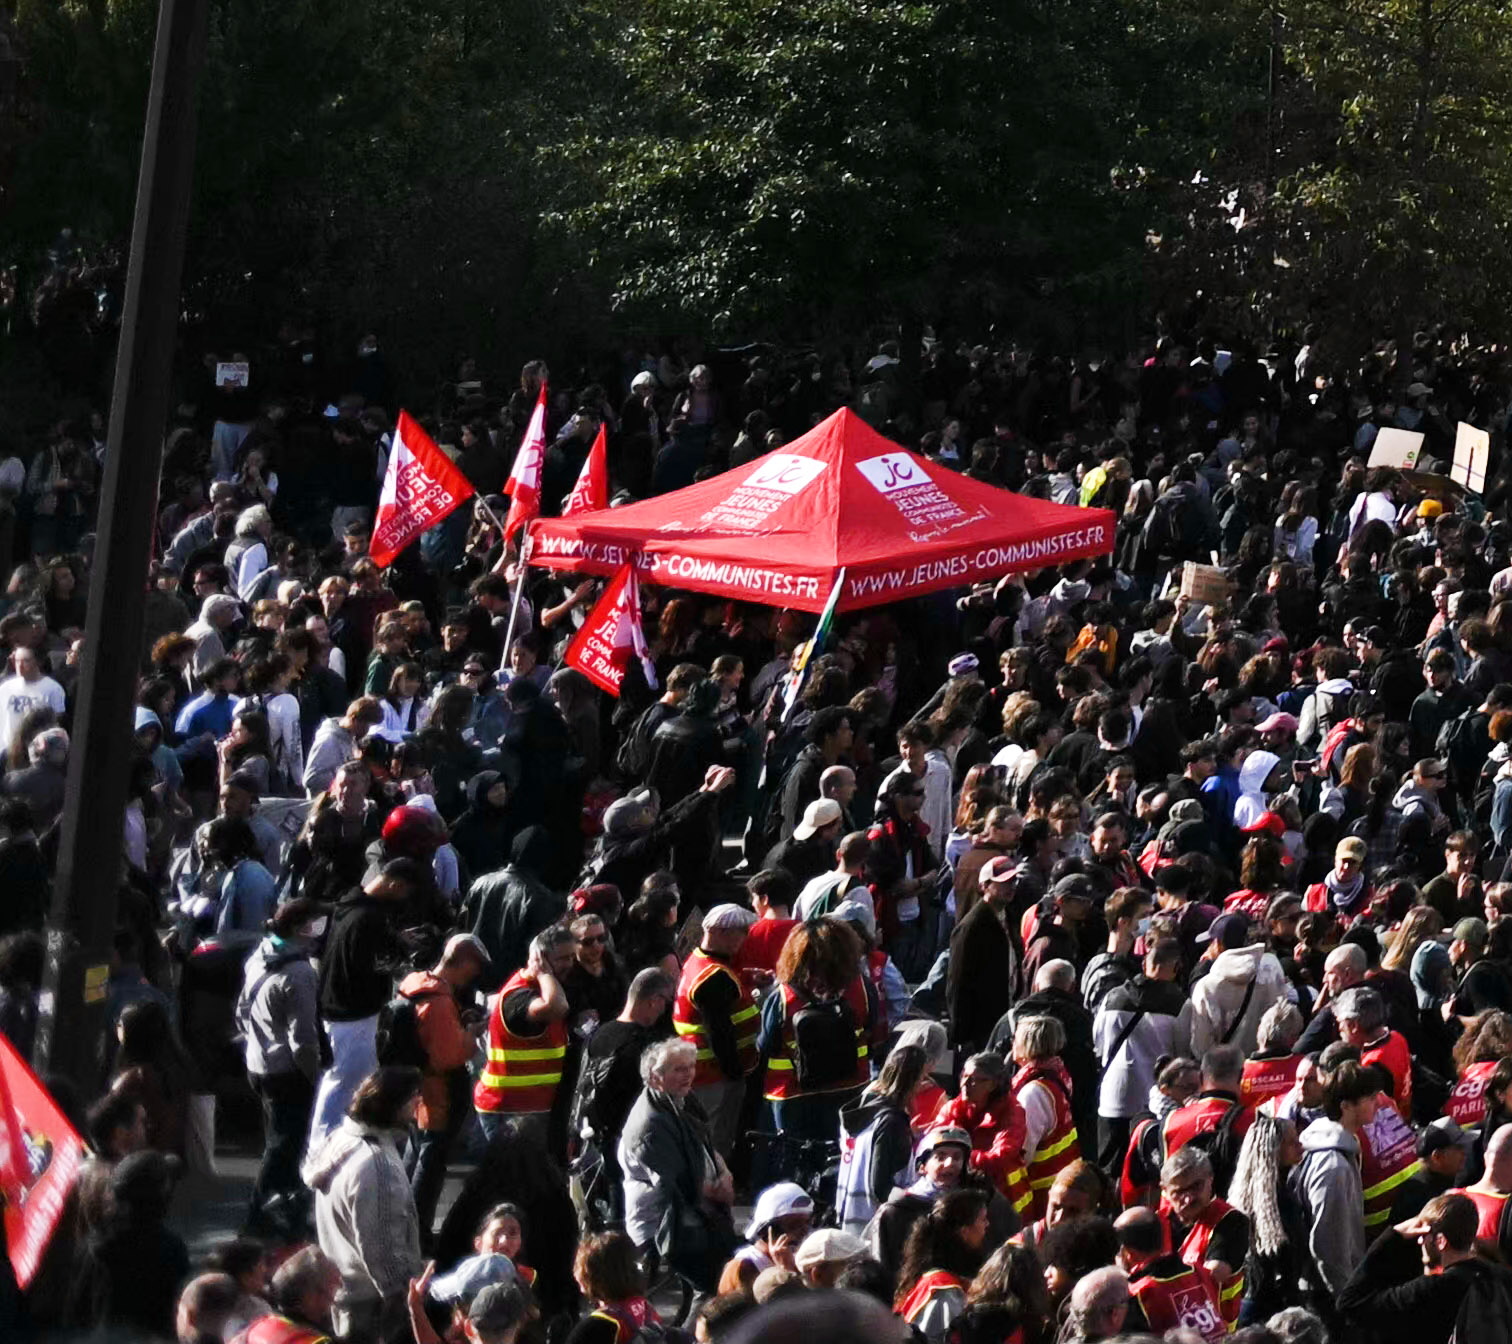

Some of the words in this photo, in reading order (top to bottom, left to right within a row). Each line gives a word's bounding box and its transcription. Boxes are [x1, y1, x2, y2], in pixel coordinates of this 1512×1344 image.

[719, 493, 783, 514] JEUNES
[896, 490, 950, 512] JEUNES
[850, 525, 1105, 598] WWW.JEUNES-COMMUNISTES.FR
[591, 653, 625, 686] FRANC
